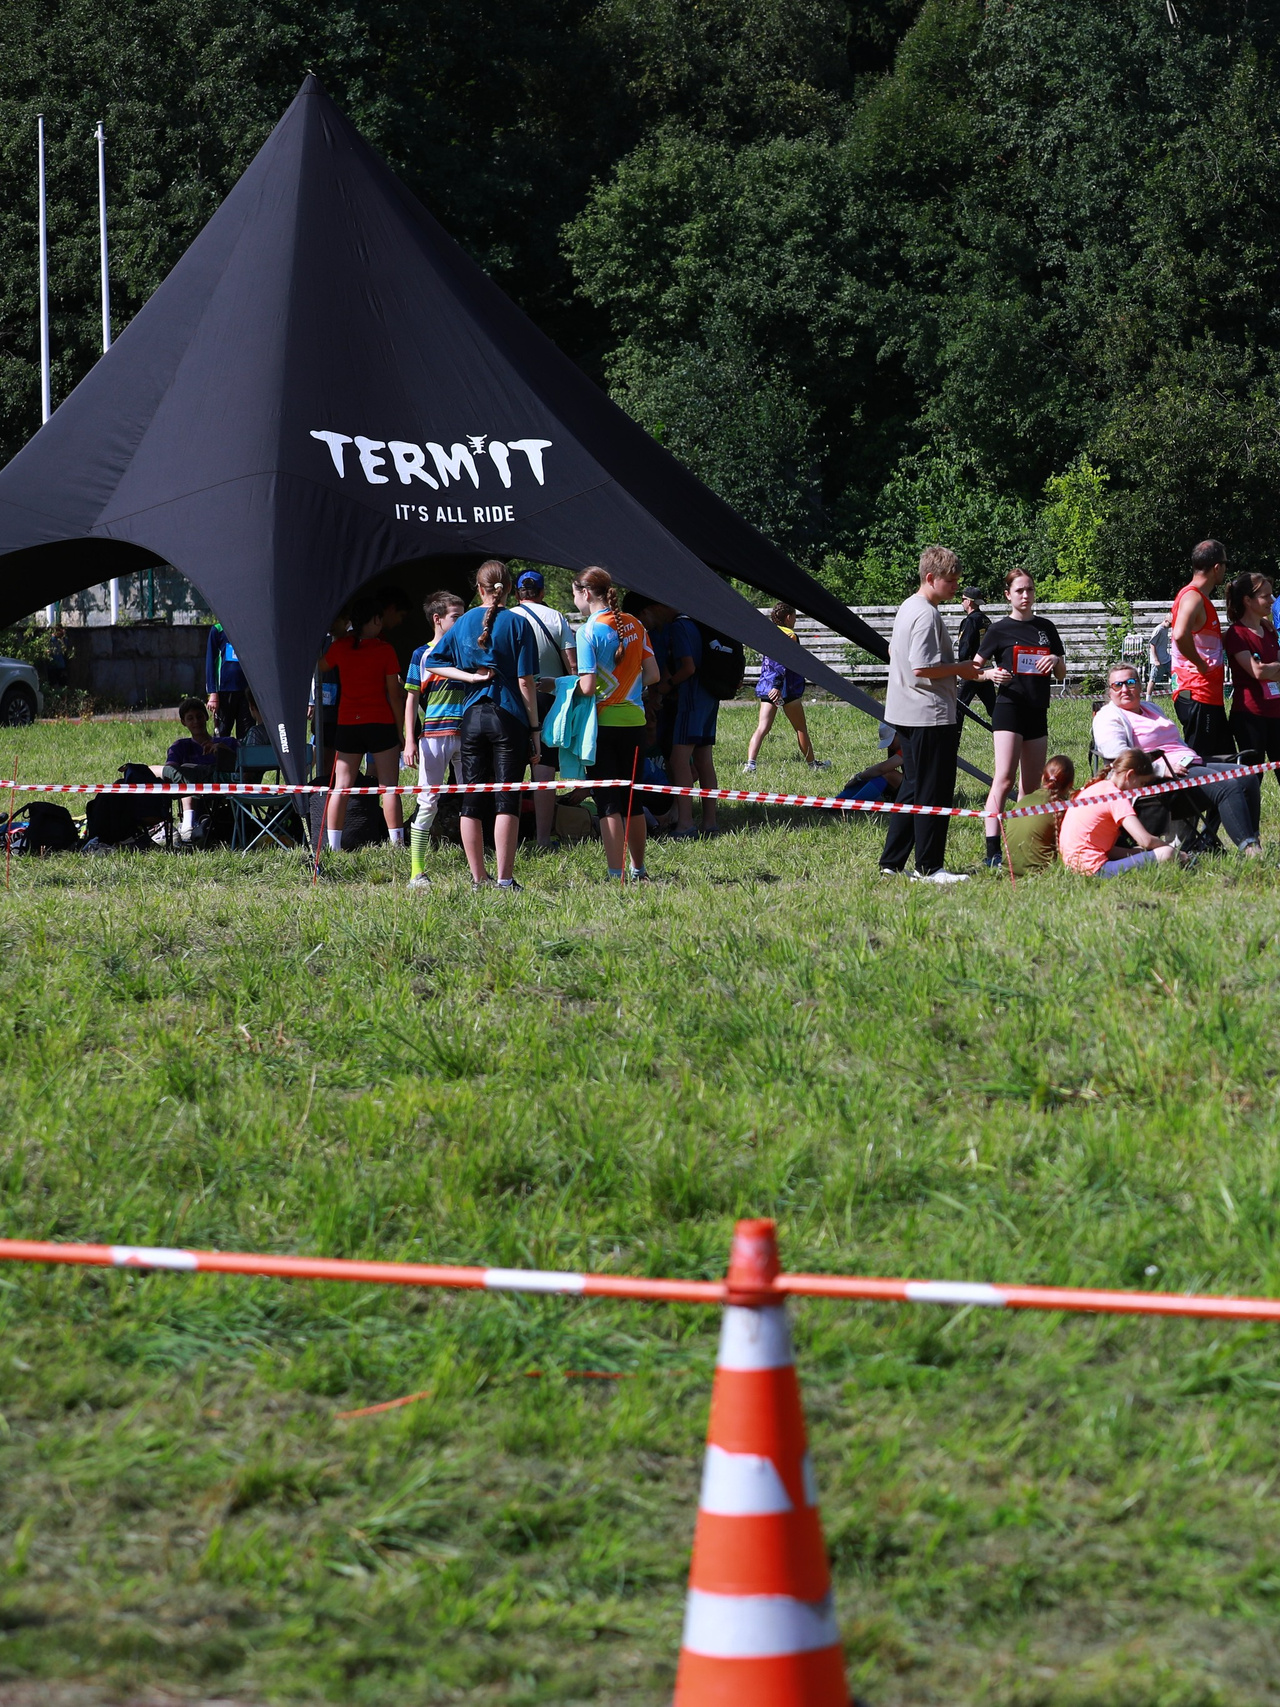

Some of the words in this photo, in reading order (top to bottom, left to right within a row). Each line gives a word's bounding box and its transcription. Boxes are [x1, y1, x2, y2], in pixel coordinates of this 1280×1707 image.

[309, 430, 553, 490] TERMIT
[395, 503, 429, 522] IT'S
[436, 505, 467, 523] ALL
[473, 504, 515, 523] RIDE
